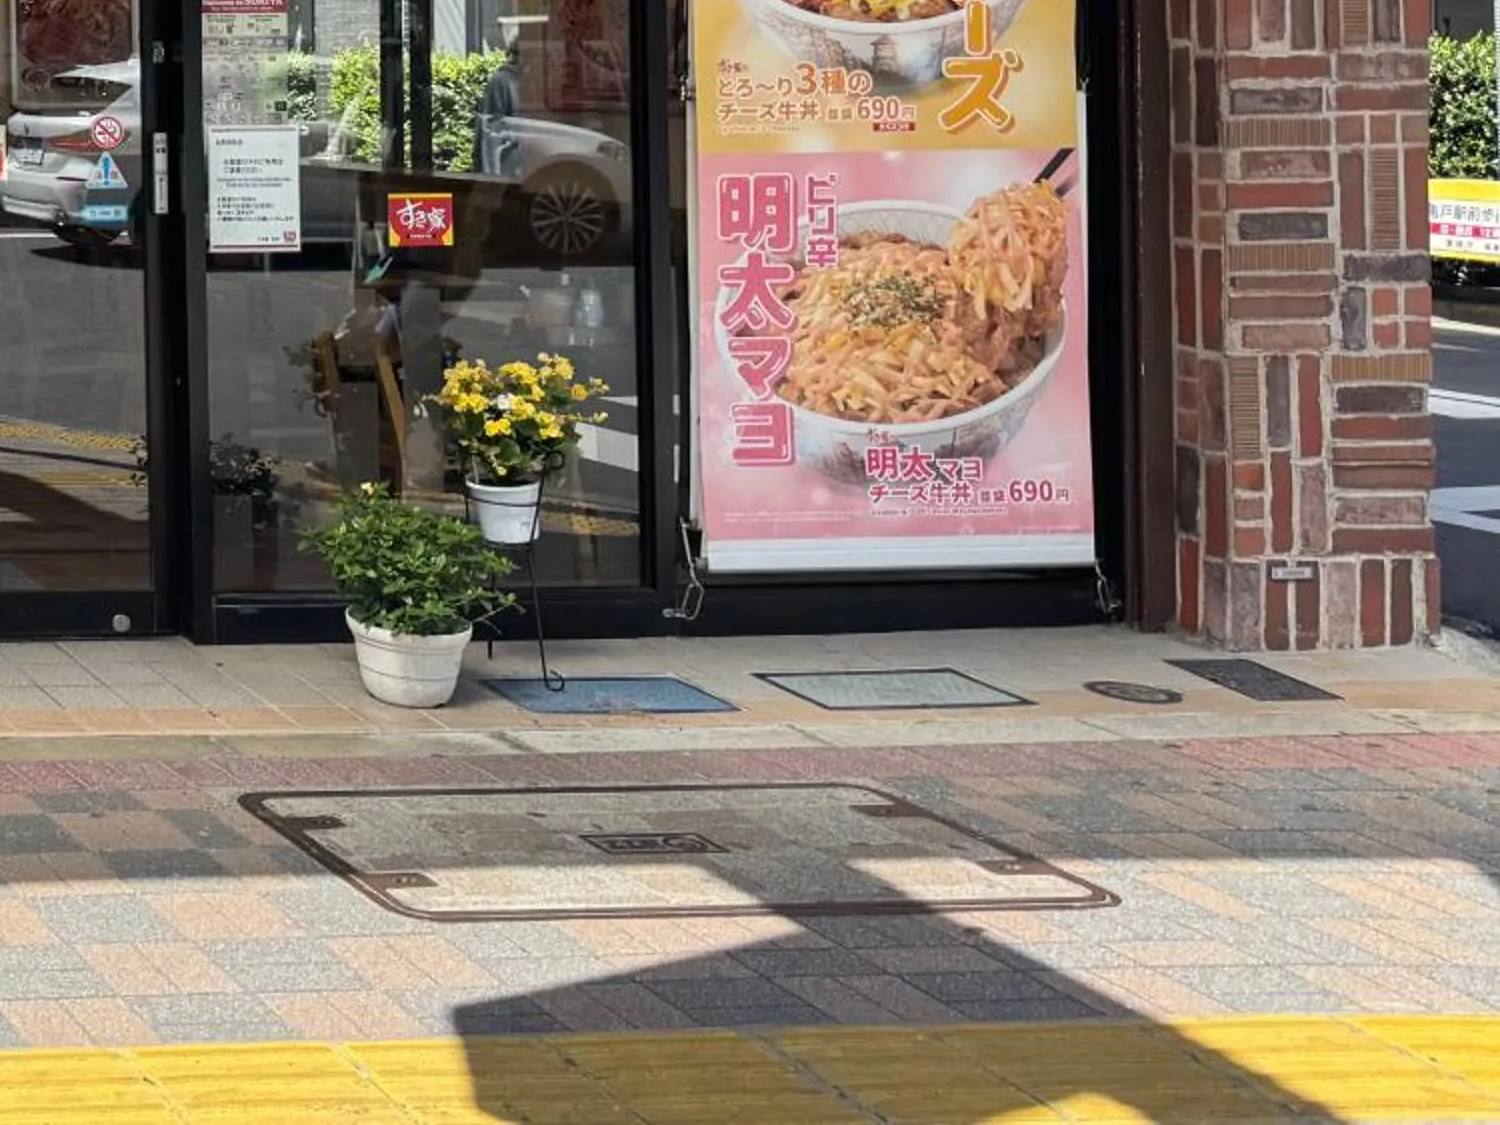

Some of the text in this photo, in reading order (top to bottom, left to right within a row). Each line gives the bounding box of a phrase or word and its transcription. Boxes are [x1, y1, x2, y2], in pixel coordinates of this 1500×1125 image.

[719, 101, 819, 121] チーズ牛丼
[396, 198, 446, 233] すき家
[807, 172, 838, 267] ピリ辛
[717, 173, 796, 465] 明太マヨ
[866, 446, 983, 481] 明太マヨ
[870, 483, 971, 504] チーズ牛丼
